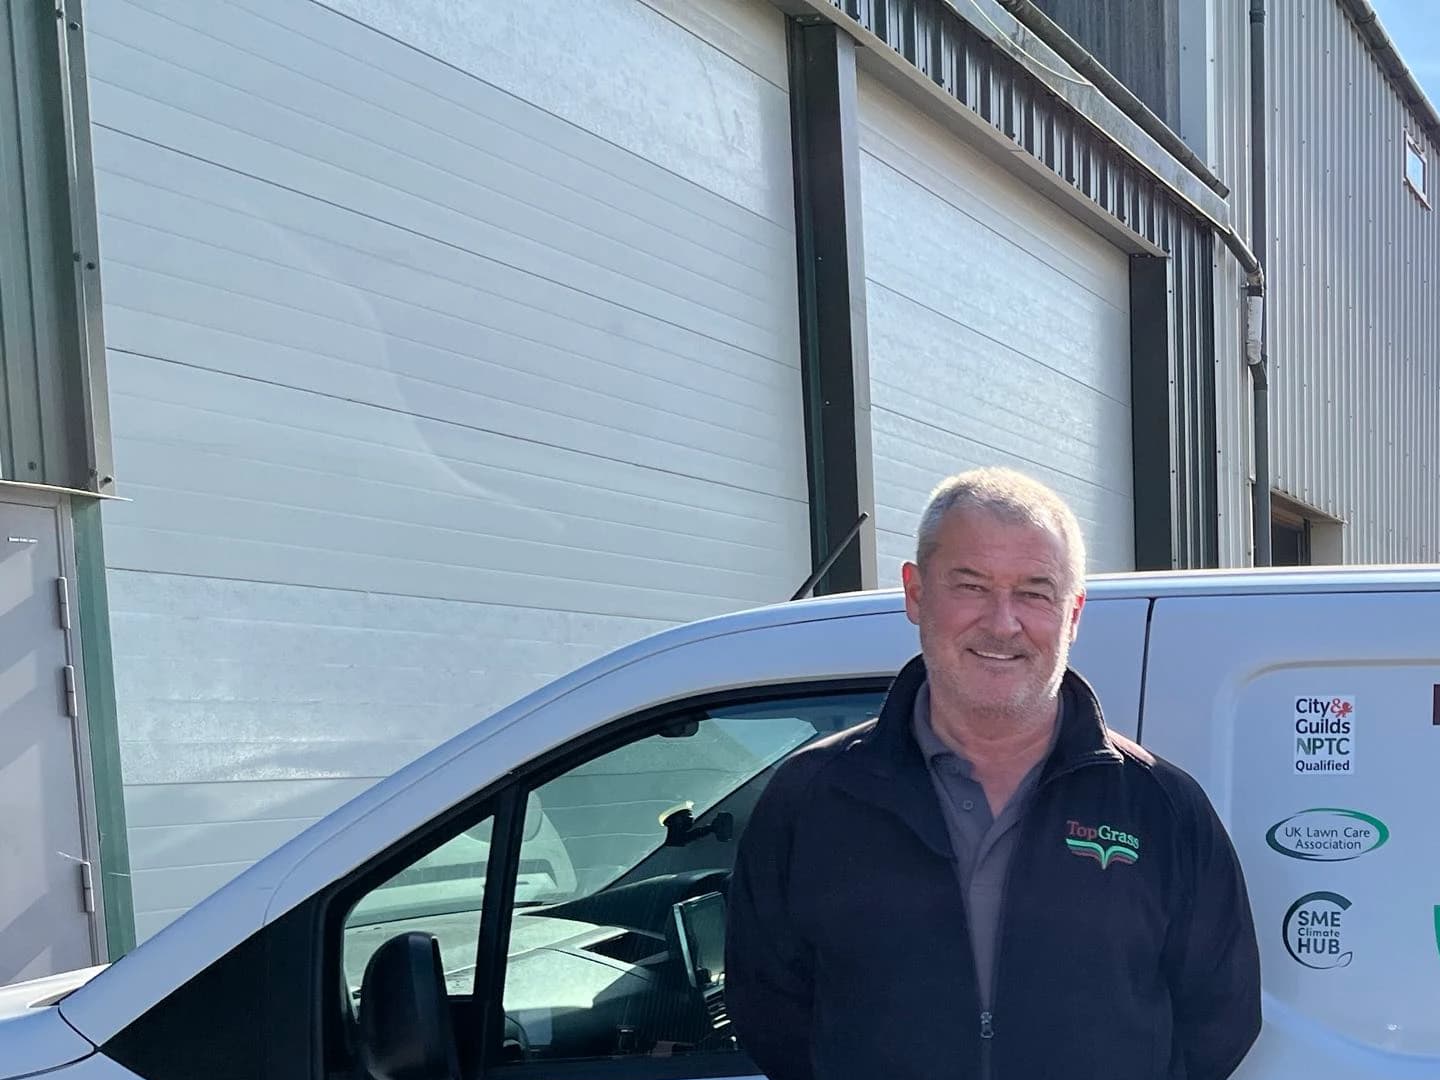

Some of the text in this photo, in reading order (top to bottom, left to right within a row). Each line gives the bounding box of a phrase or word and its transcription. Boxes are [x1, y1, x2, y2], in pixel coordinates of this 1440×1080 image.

[1295, 718, 1350, 735] Guilds
[1296, 737, 1350, 756] NPTC
[1295, 760, 1350, 772] Qualified
[1066, 820, 1139, 850] TopGrass
[1285, 827, 1371, 838] UK Lawn Care
[1296, 839, 1362, 850] Association
[1298, 911, 1341, 927] SME
[1298, 928, 1340, 937] Climate
[1298, 938, 1340, 954] HUB
